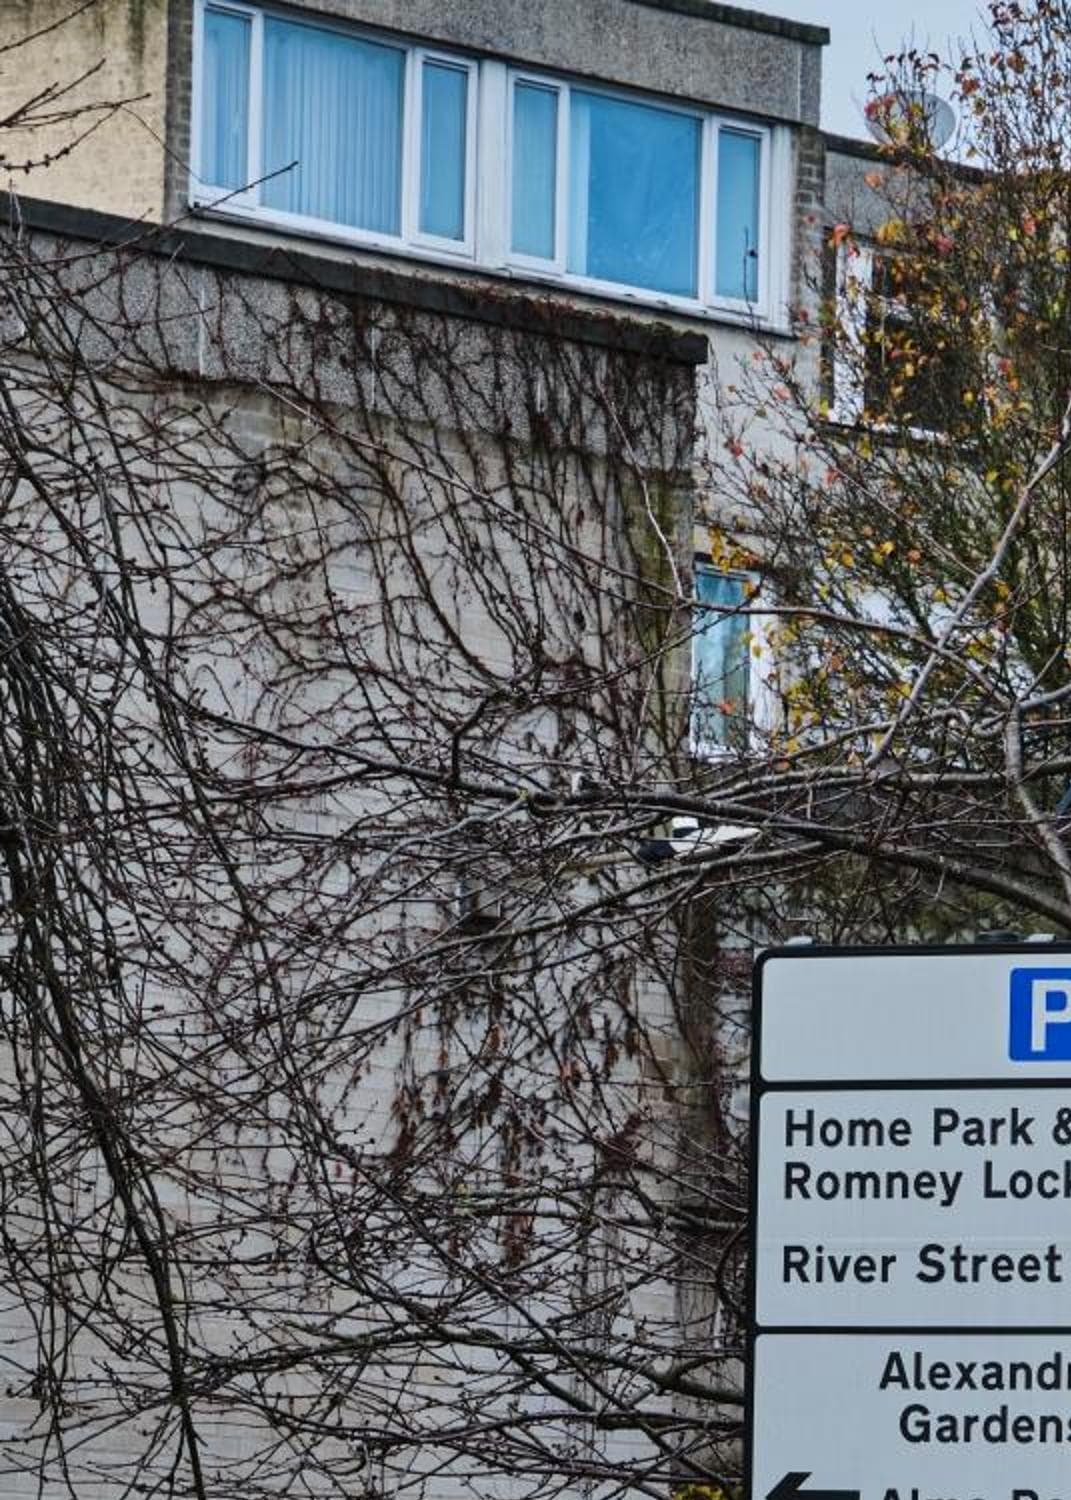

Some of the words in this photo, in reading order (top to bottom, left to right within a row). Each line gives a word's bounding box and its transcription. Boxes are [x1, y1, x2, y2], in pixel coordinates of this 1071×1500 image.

[785, 1109, 912, 1148] Home
[933, 1107, 1035, 1147] Park
[784, 1161, 963, 1207] Romney
[783, 1244, 897, 1284] River
[916, 1243, 1063, 1284] Street
